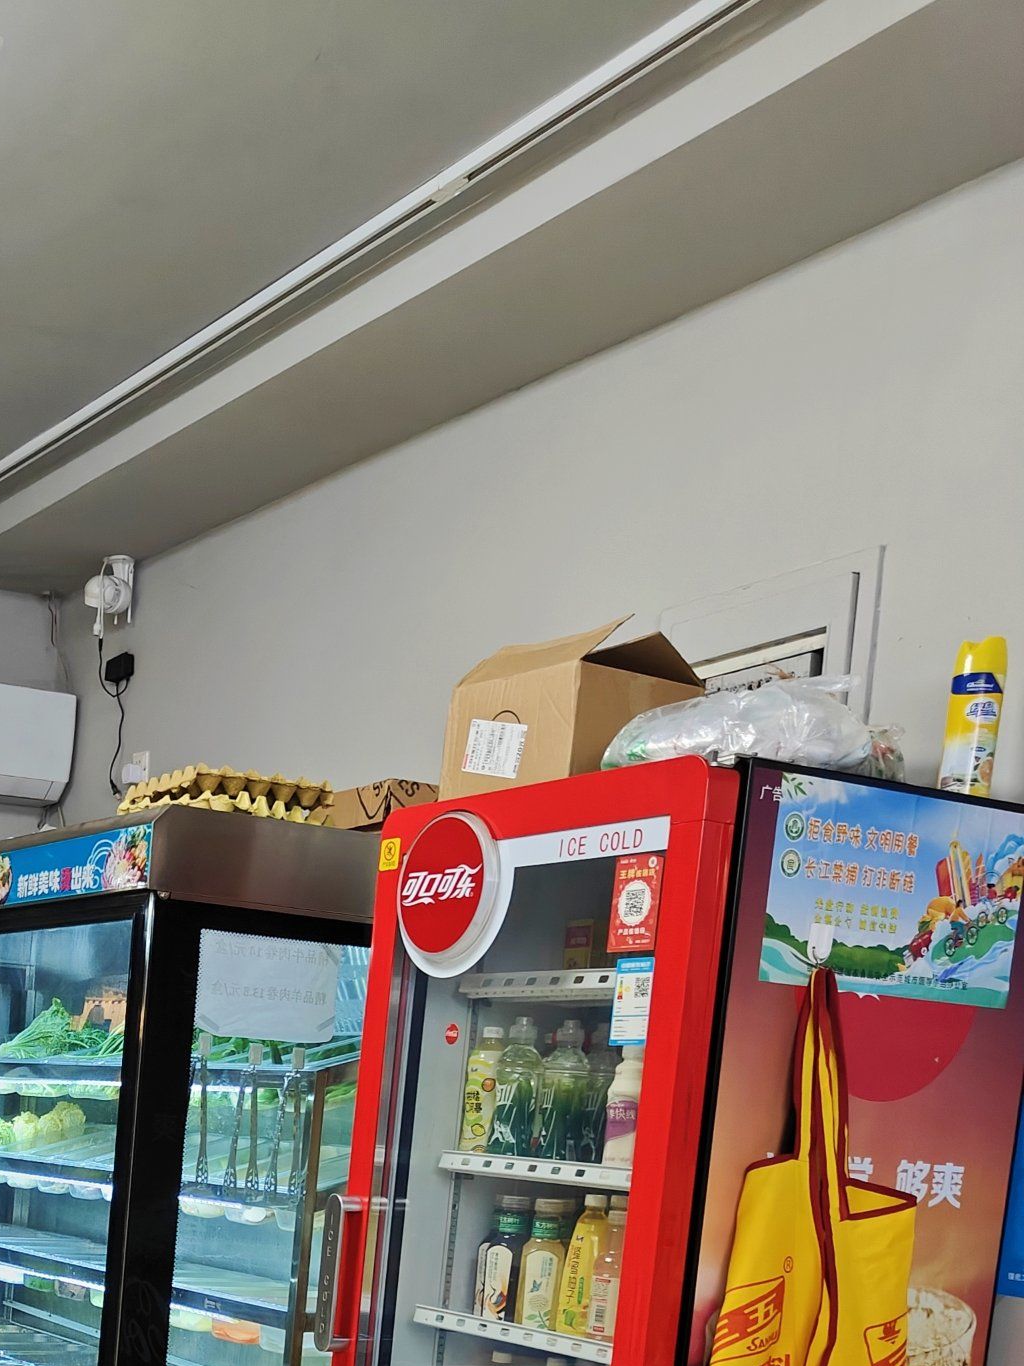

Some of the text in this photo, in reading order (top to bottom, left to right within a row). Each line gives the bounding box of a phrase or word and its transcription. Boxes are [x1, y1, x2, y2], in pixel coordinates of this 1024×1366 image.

[559, 828, 643, 858] ICE COLD
[807, 818, 919, 857] 拒食野味 文明用餐
[402, 864, 483, 907] 可口可乐
[804, 857, 858, 886] 长江禁捕
[896, 1159, 965, 1209] 够爽
